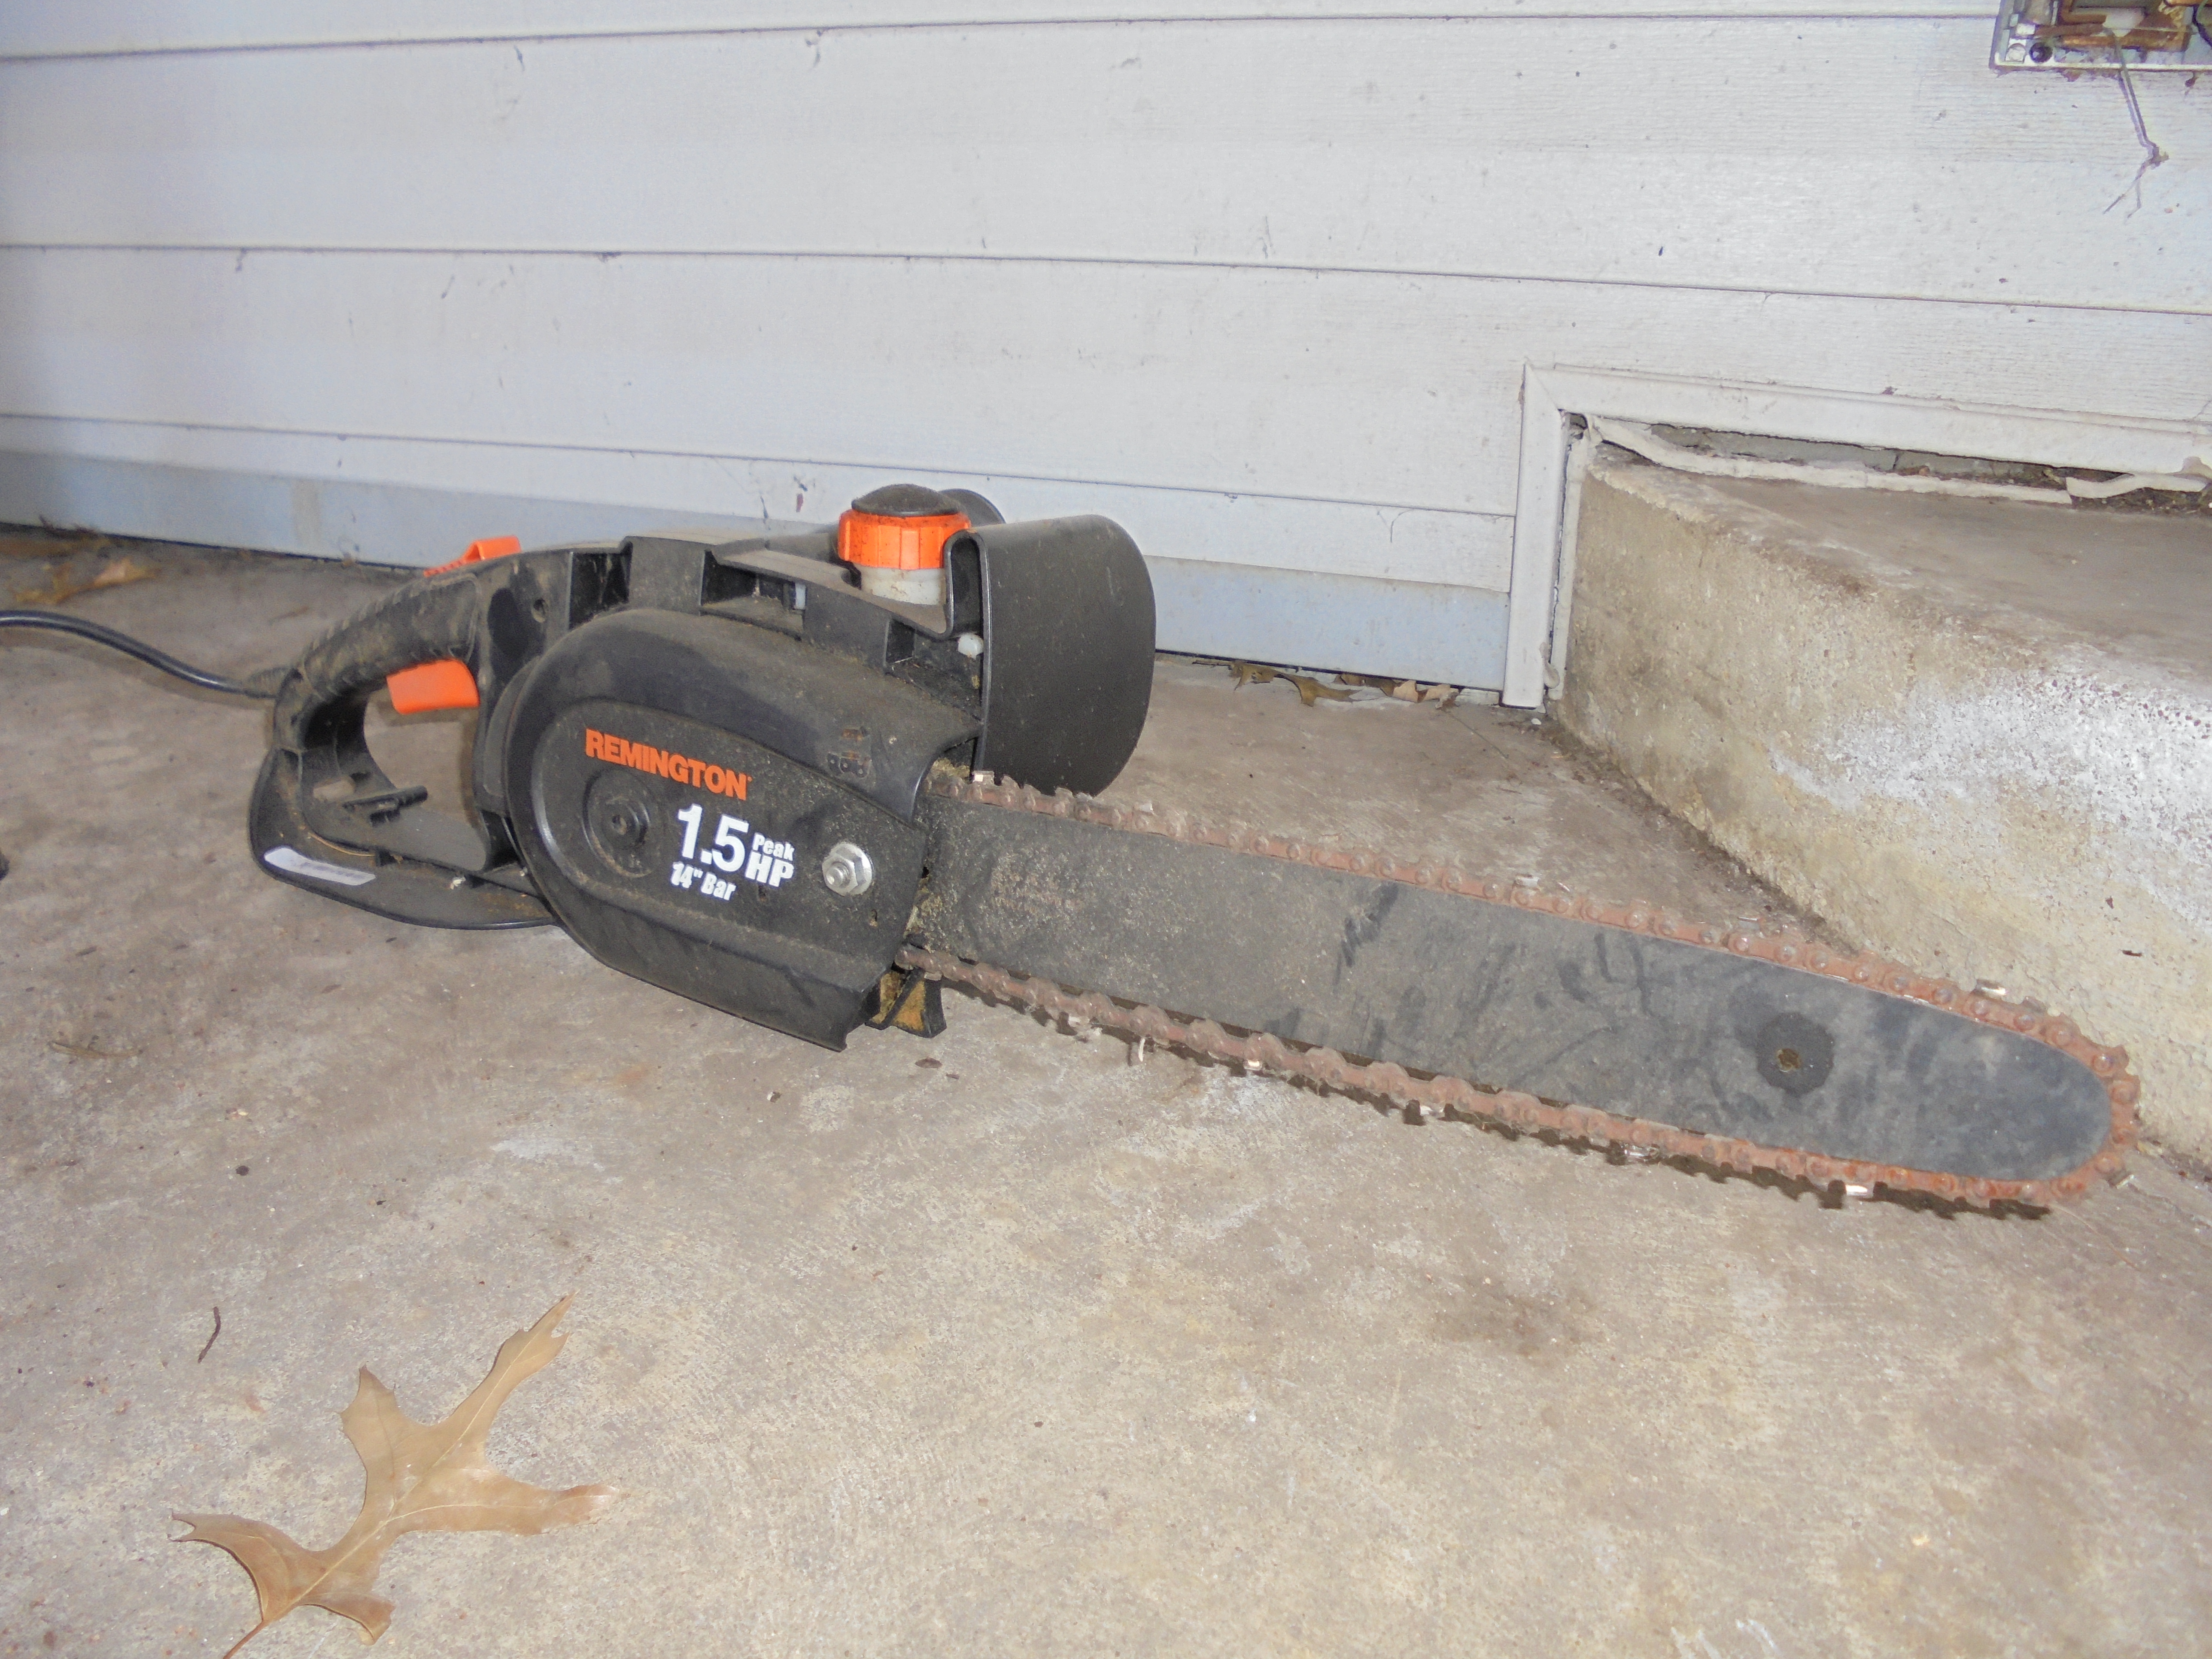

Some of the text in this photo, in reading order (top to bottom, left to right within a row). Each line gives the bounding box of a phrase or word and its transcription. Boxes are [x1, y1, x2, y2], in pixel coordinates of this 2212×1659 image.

[585, 728, 747, 801] REMINGTON
[678, 803, 749, 872] 1.5
[752, 833, 795, 861] Peak
[671, 861, 736, 900] 14" Bar
[745, 851, 794, 887] HP
